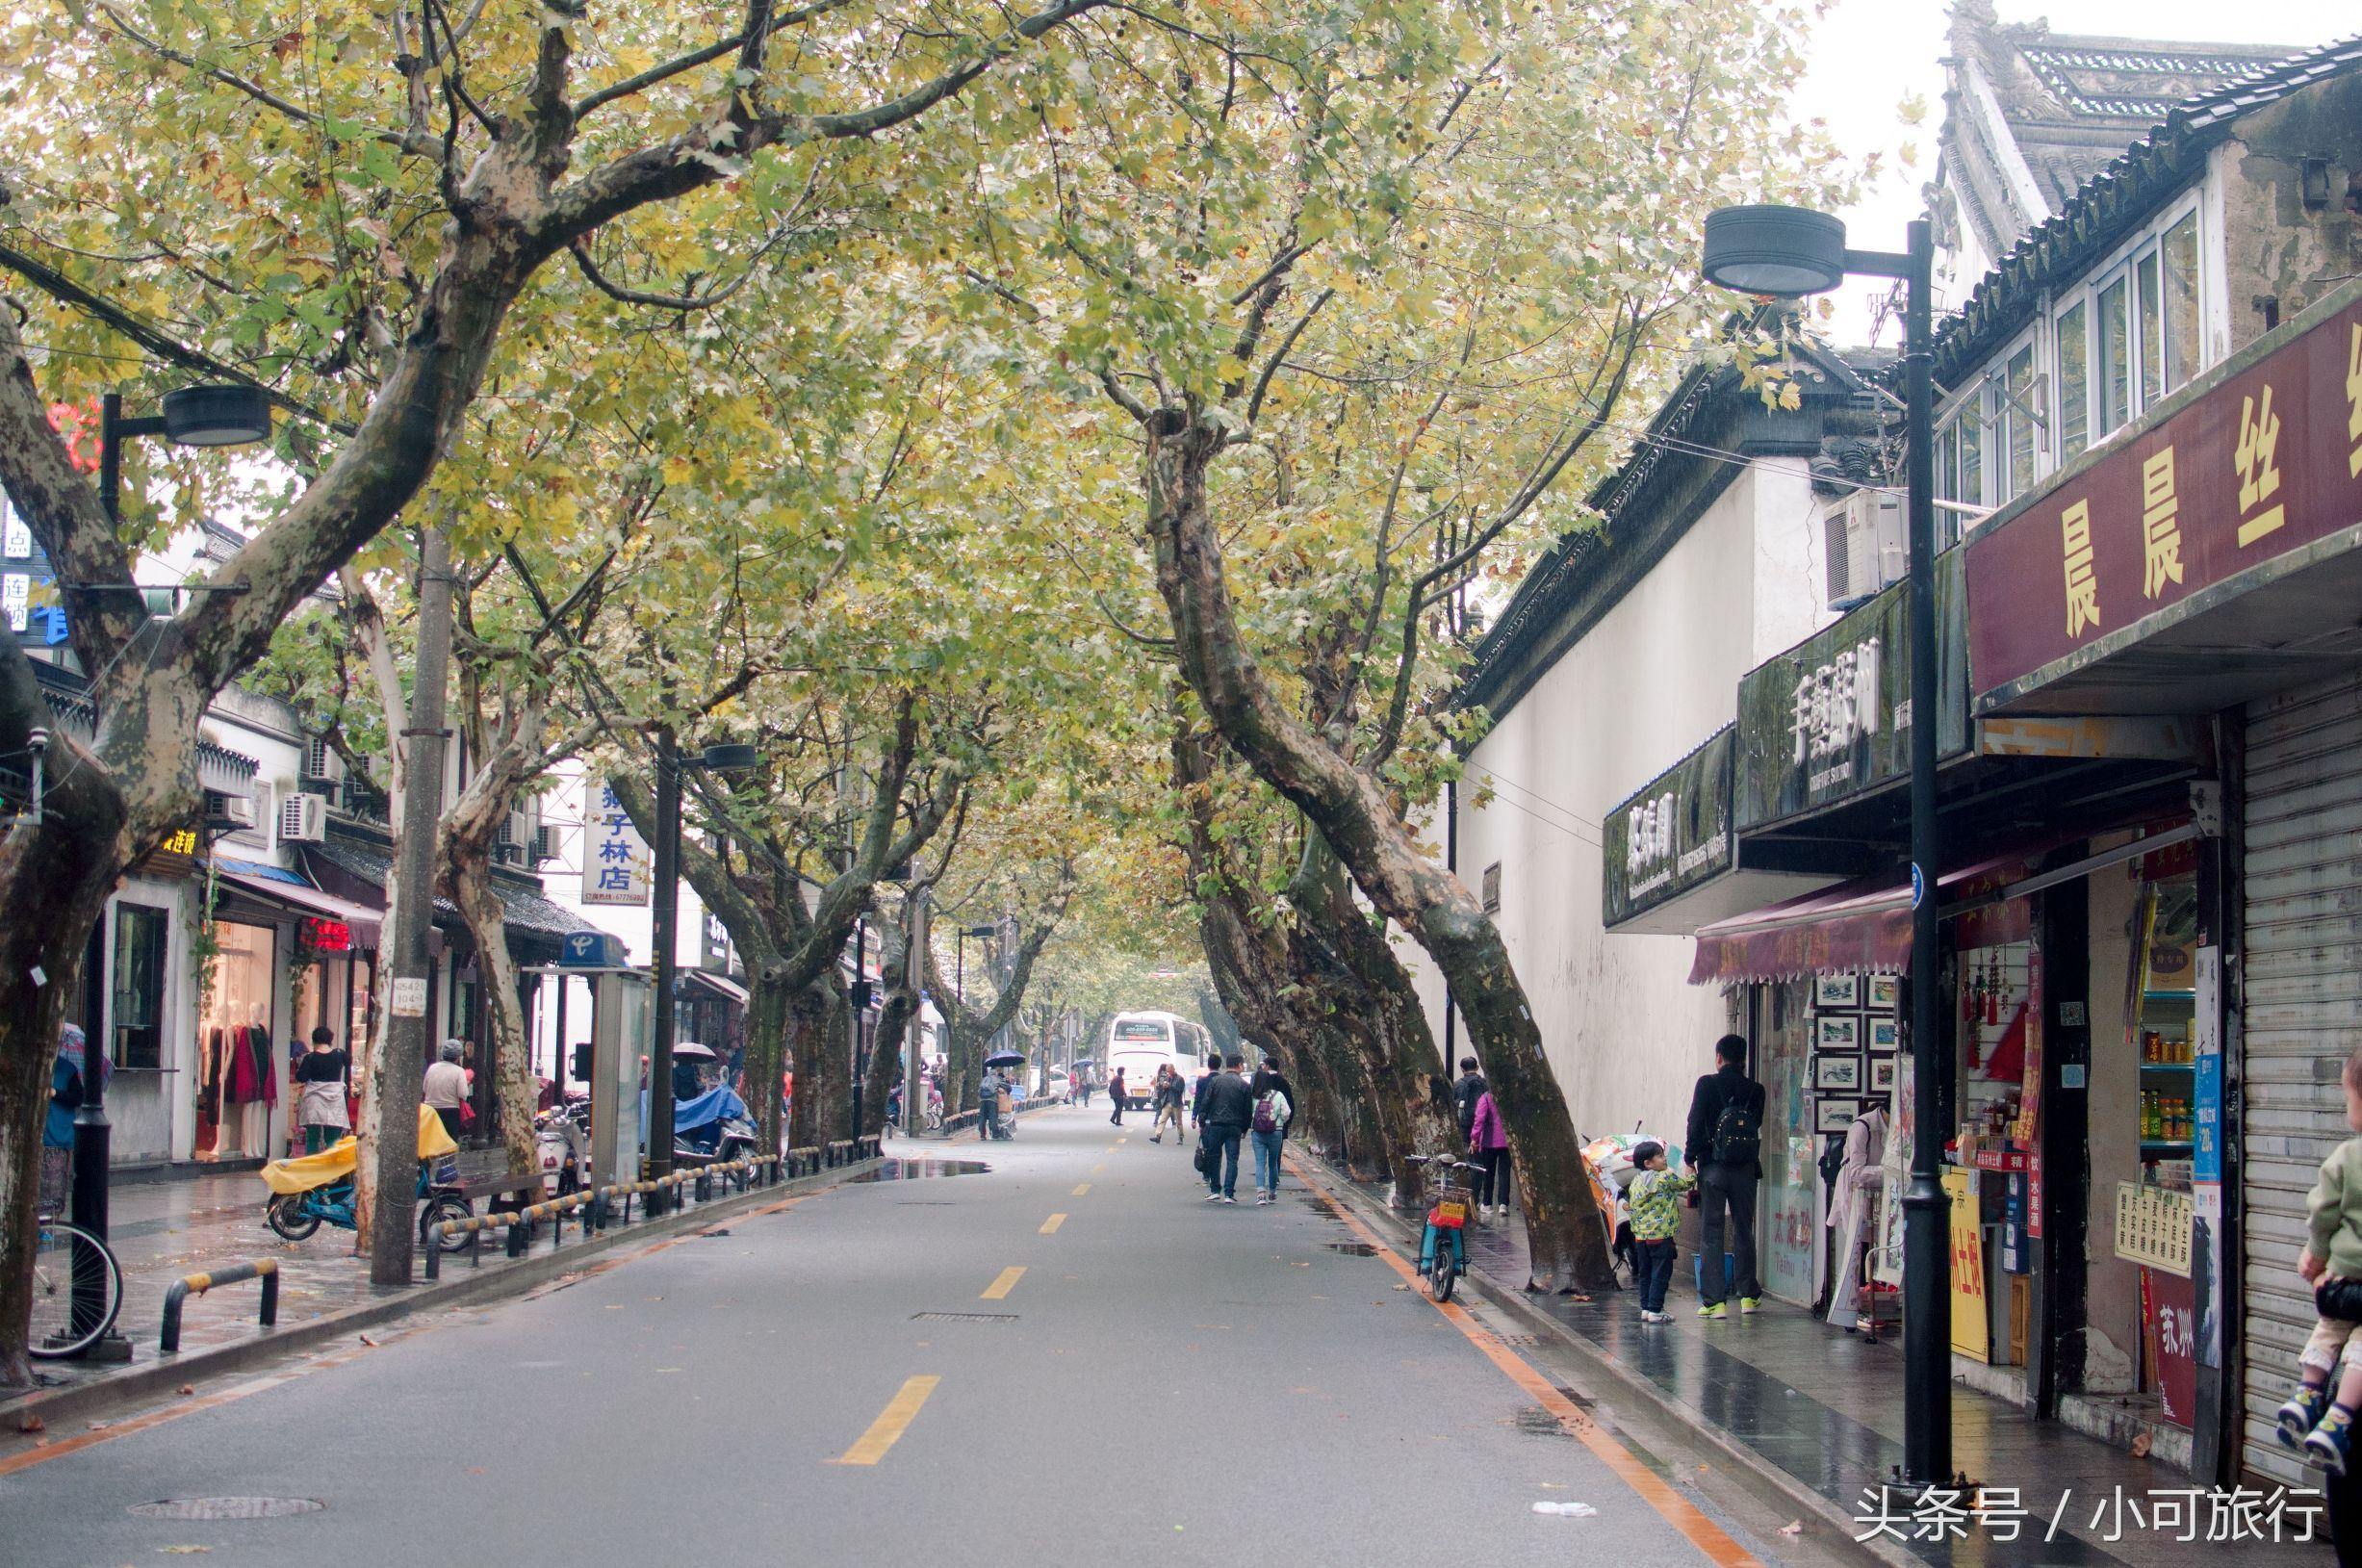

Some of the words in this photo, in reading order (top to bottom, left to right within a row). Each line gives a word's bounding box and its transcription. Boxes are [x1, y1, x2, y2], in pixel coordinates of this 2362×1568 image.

[6, 578, 28, 626] 连锁
[2029, 1179, 2040, 1227] 水果酒
[2159, 1303, 2195, 1357] 苏州
